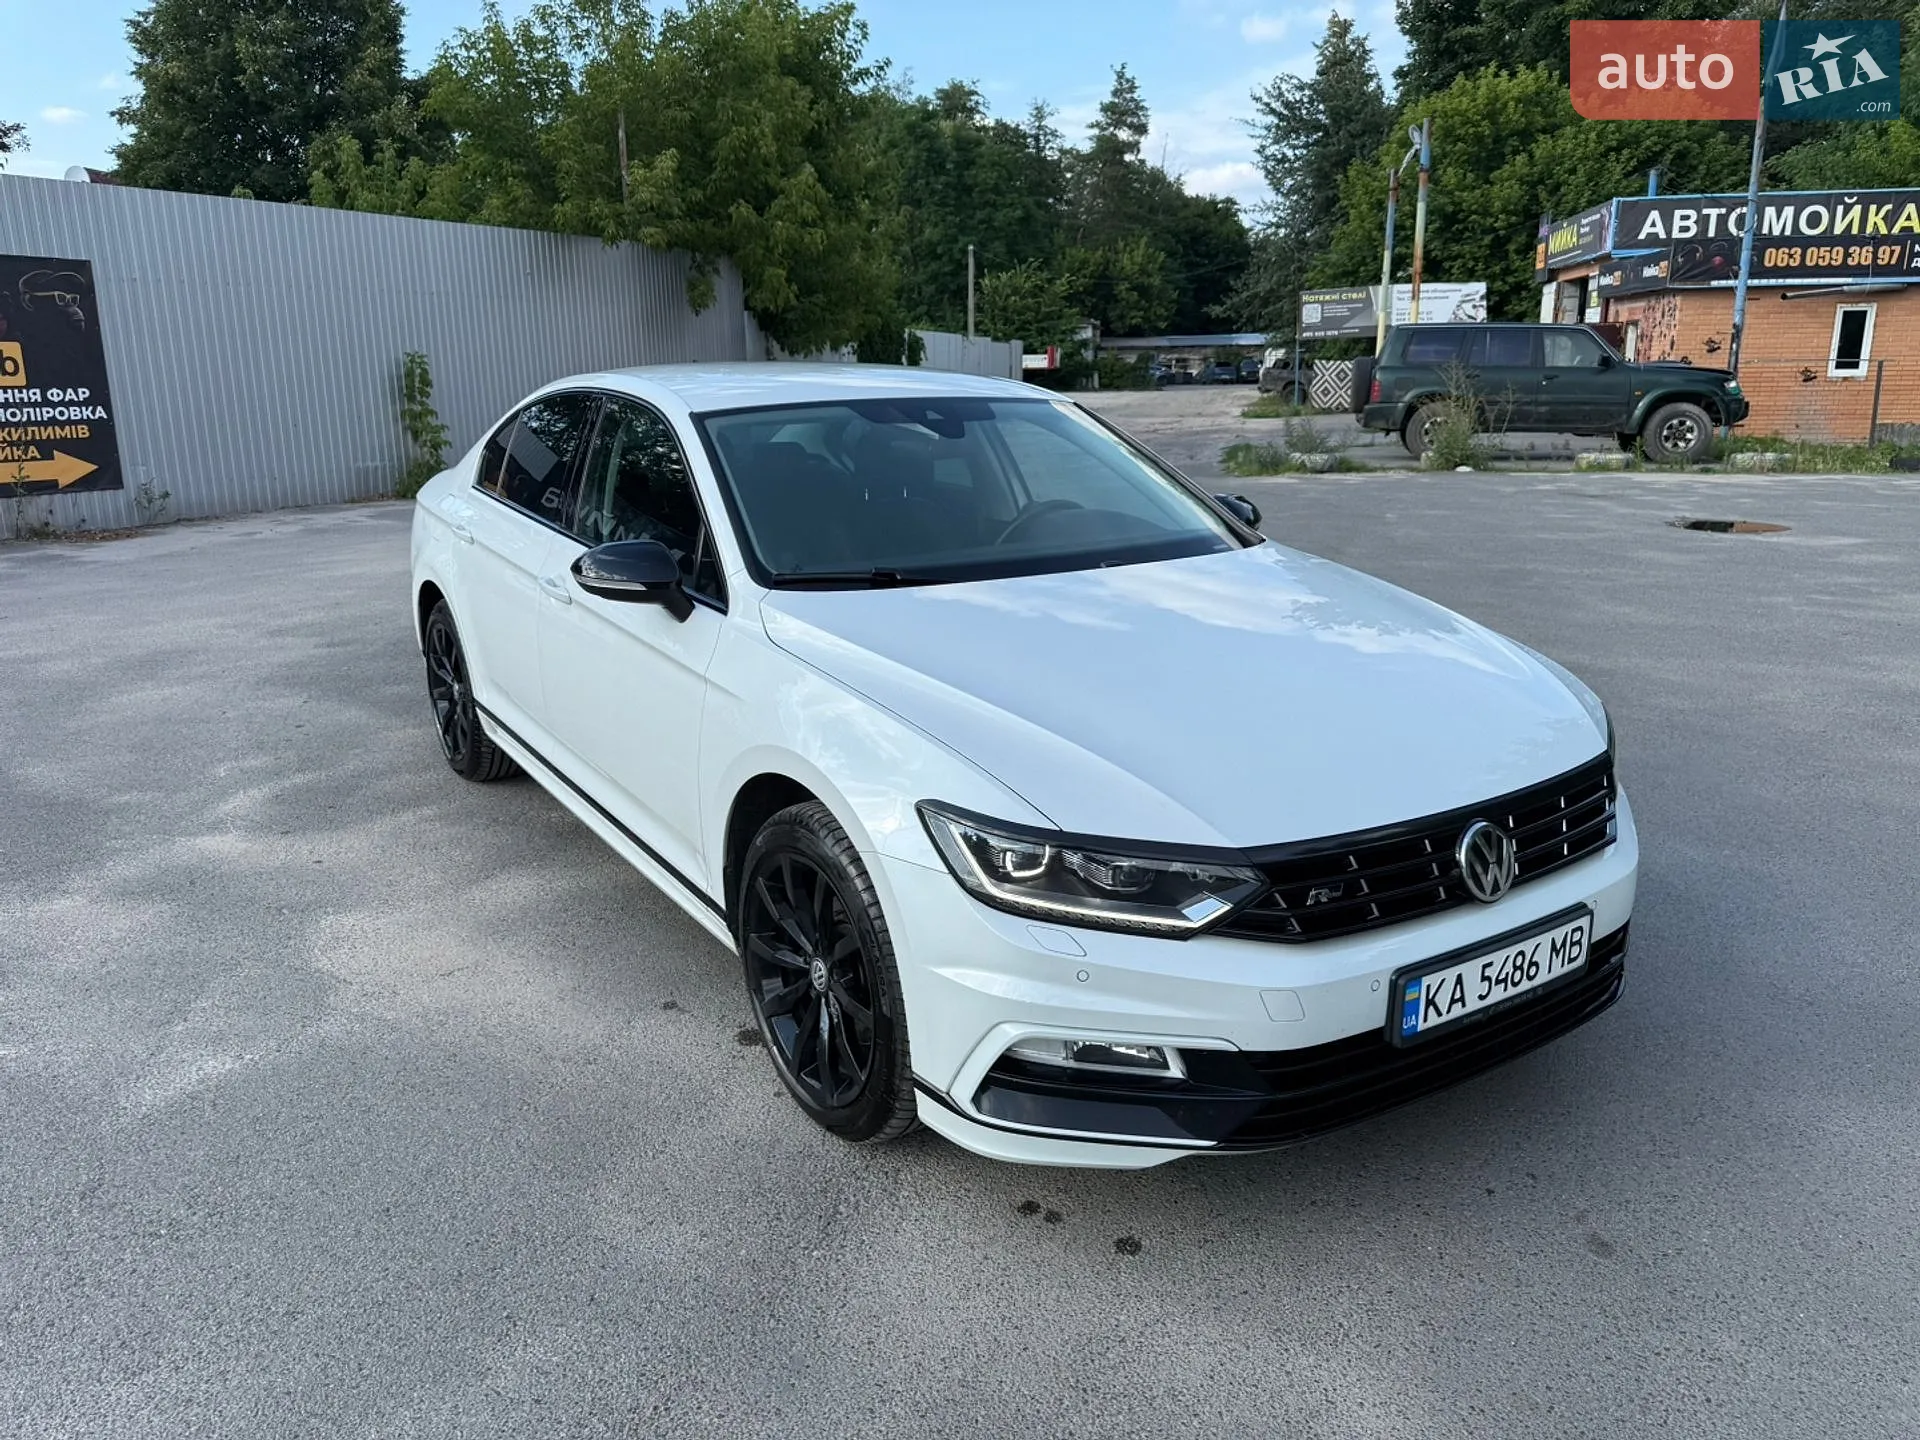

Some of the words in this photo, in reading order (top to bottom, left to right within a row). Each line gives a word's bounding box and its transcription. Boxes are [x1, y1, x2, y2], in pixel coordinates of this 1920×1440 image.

[1637, 195, 1920, 240] АВТОМОЙКА
[1764, 248, 1801, 268] 063
[1805, 246, 1844, 267] 059
[1847, 245, 1873, 266] 36
[1877, 245, 1902, 266] 97
[47, 387, 91, 402] ФАР
[1422, 972, 1468, 1024] KA
[1477, 942, 1542, 1002] 5486
[1547, 925, 1585, 975] MB
[1402, 1014, 1418, 1030] UA
